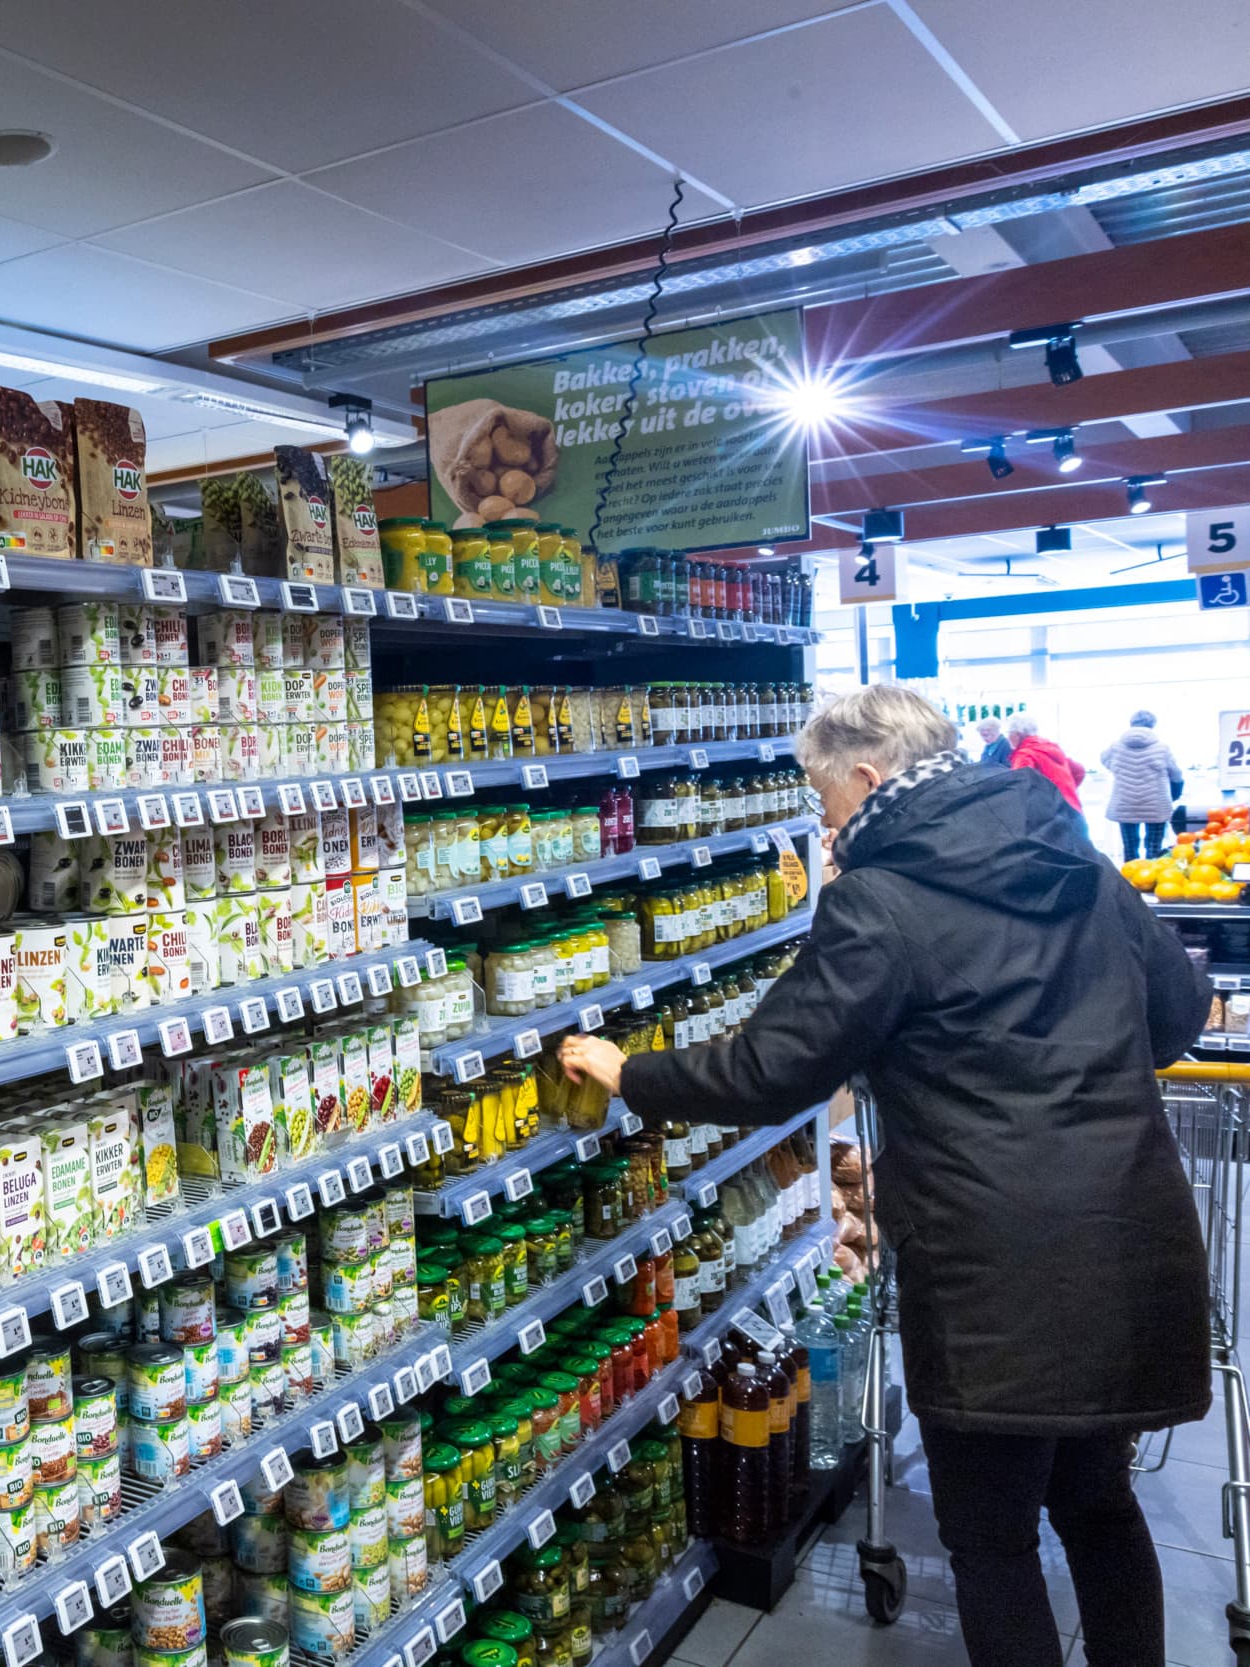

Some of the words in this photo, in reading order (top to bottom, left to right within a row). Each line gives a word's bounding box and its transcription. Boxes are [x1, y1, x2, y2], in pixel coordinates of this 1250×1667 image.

[663, 336, 785, 380] prakken,
[647, 373, 735, 406] stoven
[640, 413, 679, 434] uit
[682, 404, 715, 424] de
[21, 457, 58, 483] HAK
[113, 470, 142, 491] HAK
[112, 503, 146, 521] Linzen
[308, 504, 327, 521] HAK
[352, 512, 377, 529] HAK
[762, 525, 801, 537] JUMBO
[1208, 520, 1237, 554] 5
[854, 559, 881, 587] 4
[285, 680, 305, 691] DOP
[185, 838, 211, 853] LIMA
[115, 855, 145, 869] BONEN
[17, 949, 61, 967] LINZEN
[95, 1142, 124, 1164] KIKKER
[51, 1157, 86, 1180] EDAMAME
[96, 1160, 123, 1177] ERWTEN
[2, 1171, 37, 1195] BELUGA
[52, 1175, 76, 1193] BONEN
[3, 1191, 29, 1209] LINZEN
[8, 1480, 23, 1492] BIO
[49, 1520, 65, 1533] BIO
